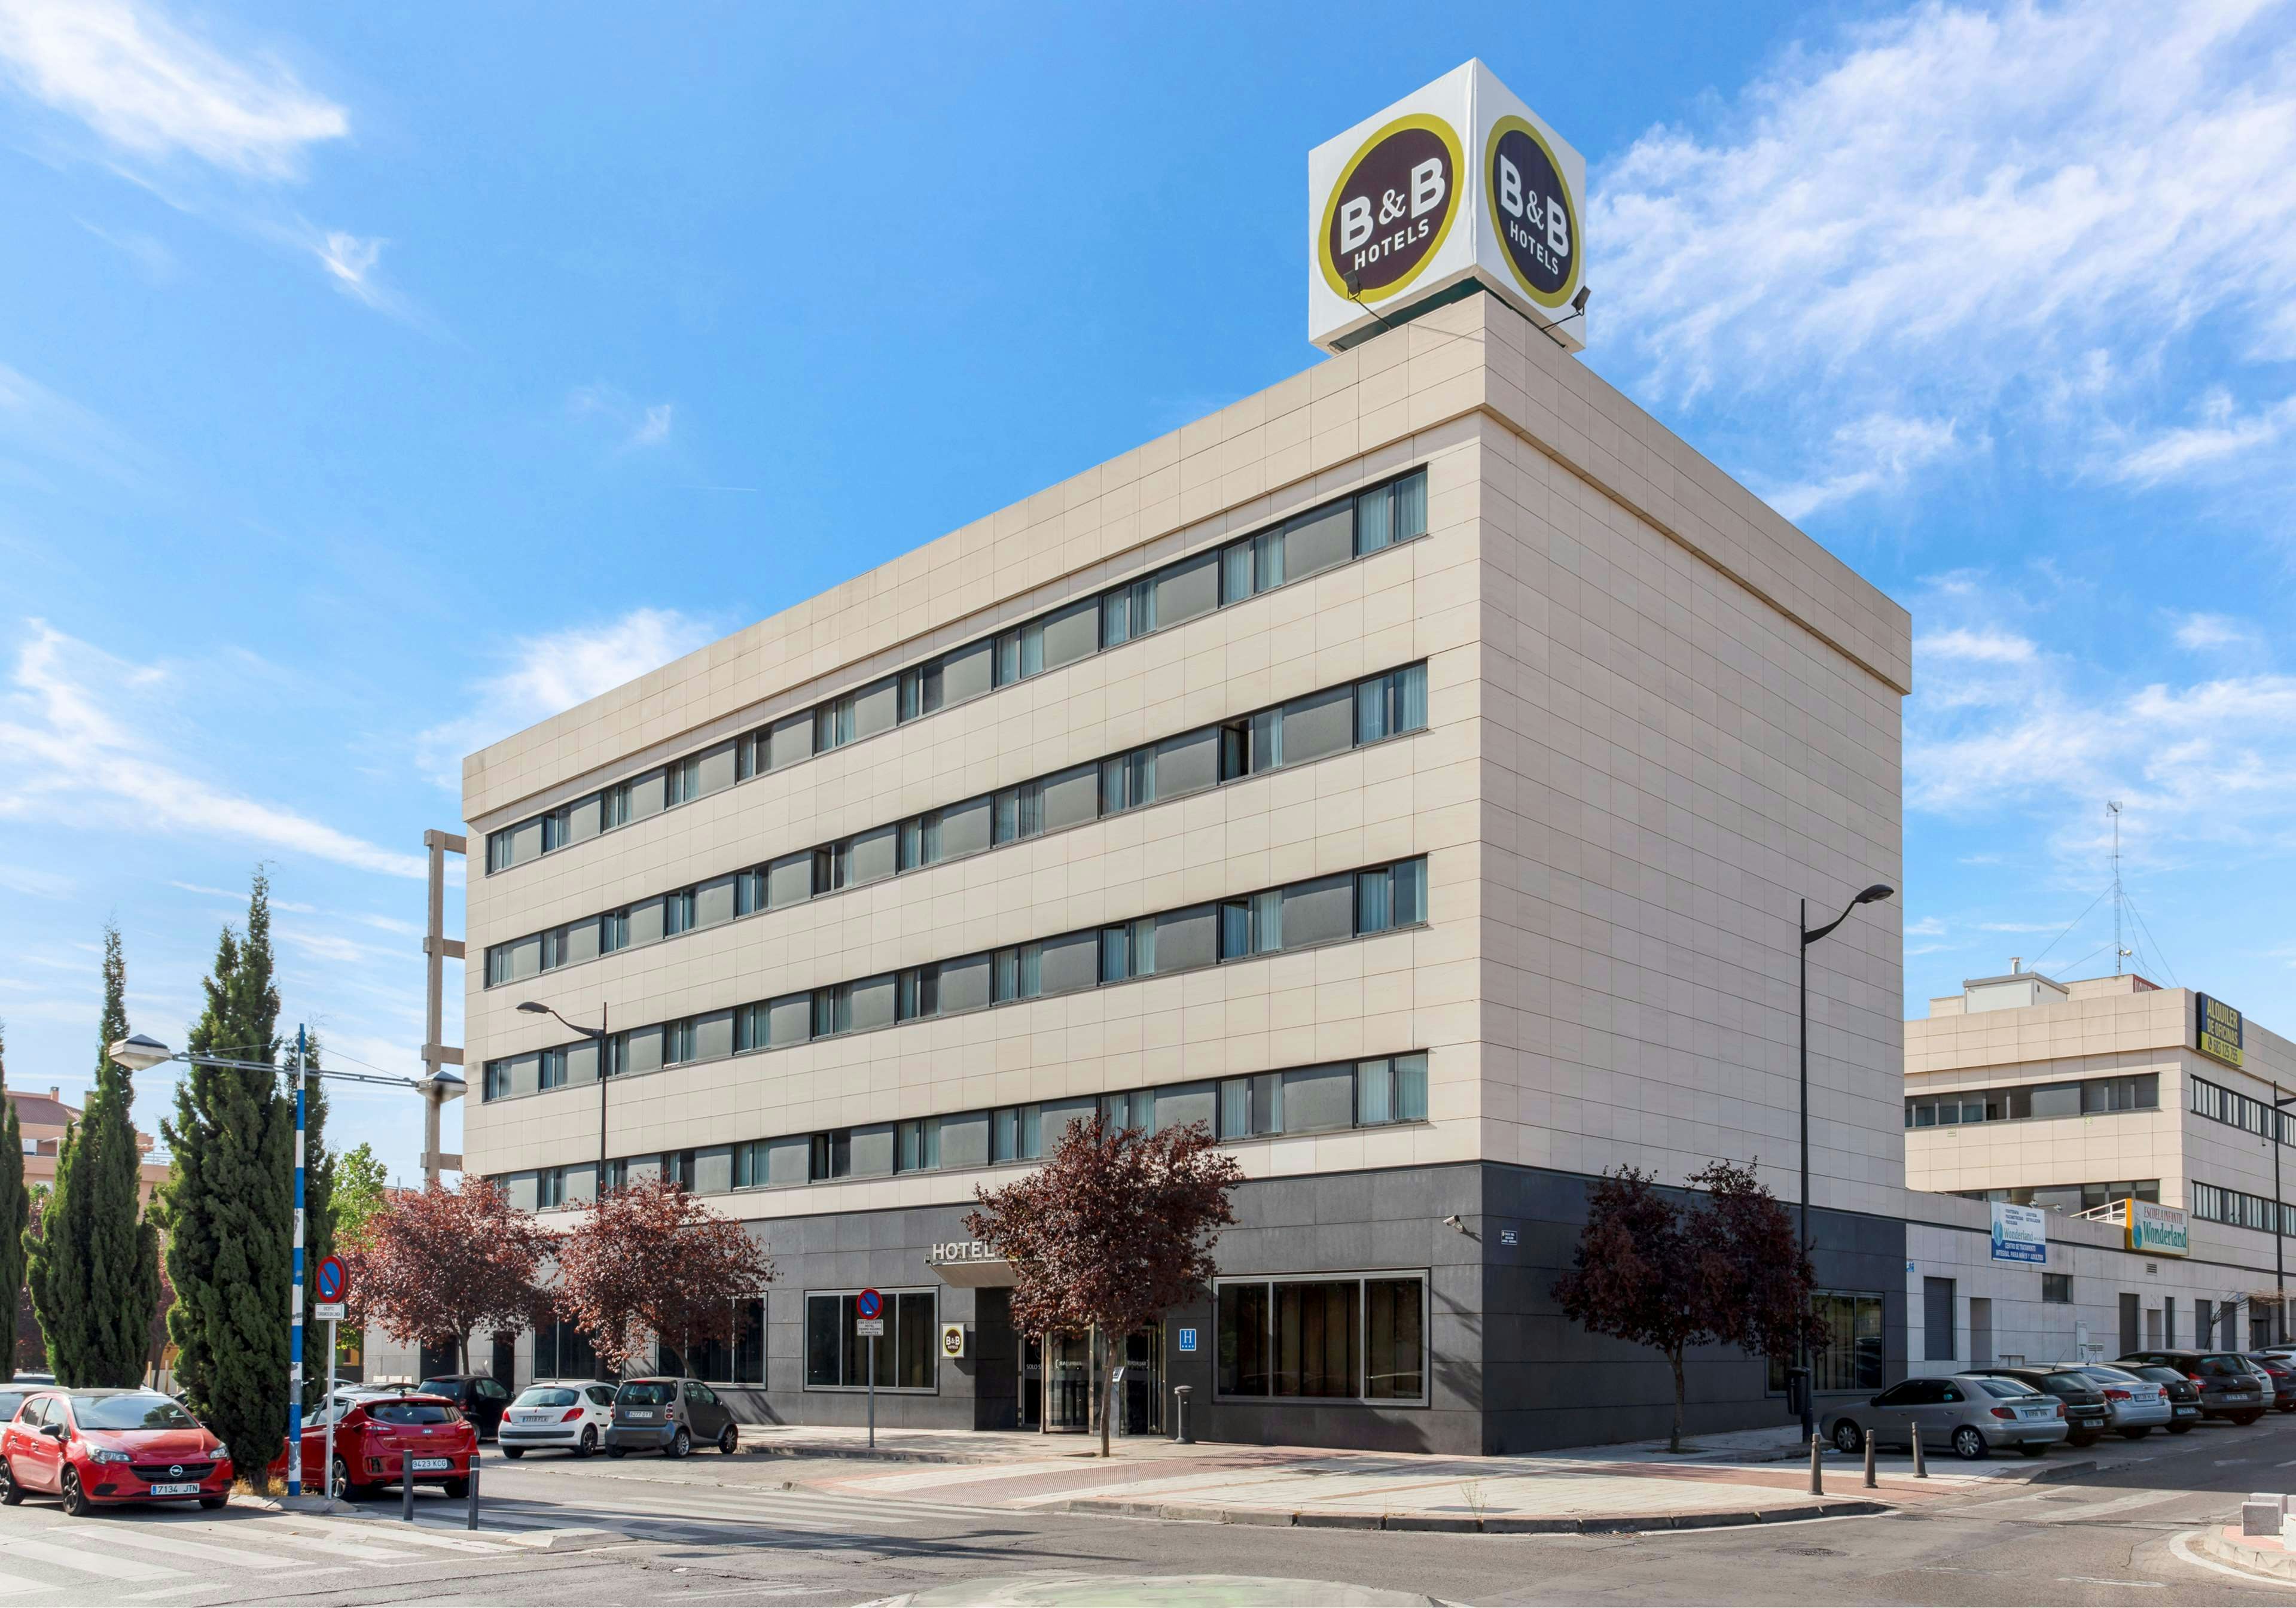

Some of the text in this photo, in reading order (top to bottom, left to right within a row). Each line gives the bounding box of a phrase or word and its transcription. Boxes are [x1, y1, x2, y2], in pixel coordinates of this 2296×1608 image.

[1341, 157, 1446, 255] B&B
[1500, 153, 1569, 257] B&B
[1354, 218, 1429, 270] HOTELS
[1510, 220, 1559, 275] HOTELS
[2207, 998, 2238, 1030] ALQUILER
[2207, 1018, 2239, 1046] DE OFICINAS
[2143, 1206, 2184, 1225] ESCUELA INFANTIL
[2004, 1227, 2033, 1241] Wonderland
[2143, 1220, 2187, 1248] Wonderland
[932, 1241, 995, 1260] HOTEL
[946, 1336, 961, 1345] B&B
